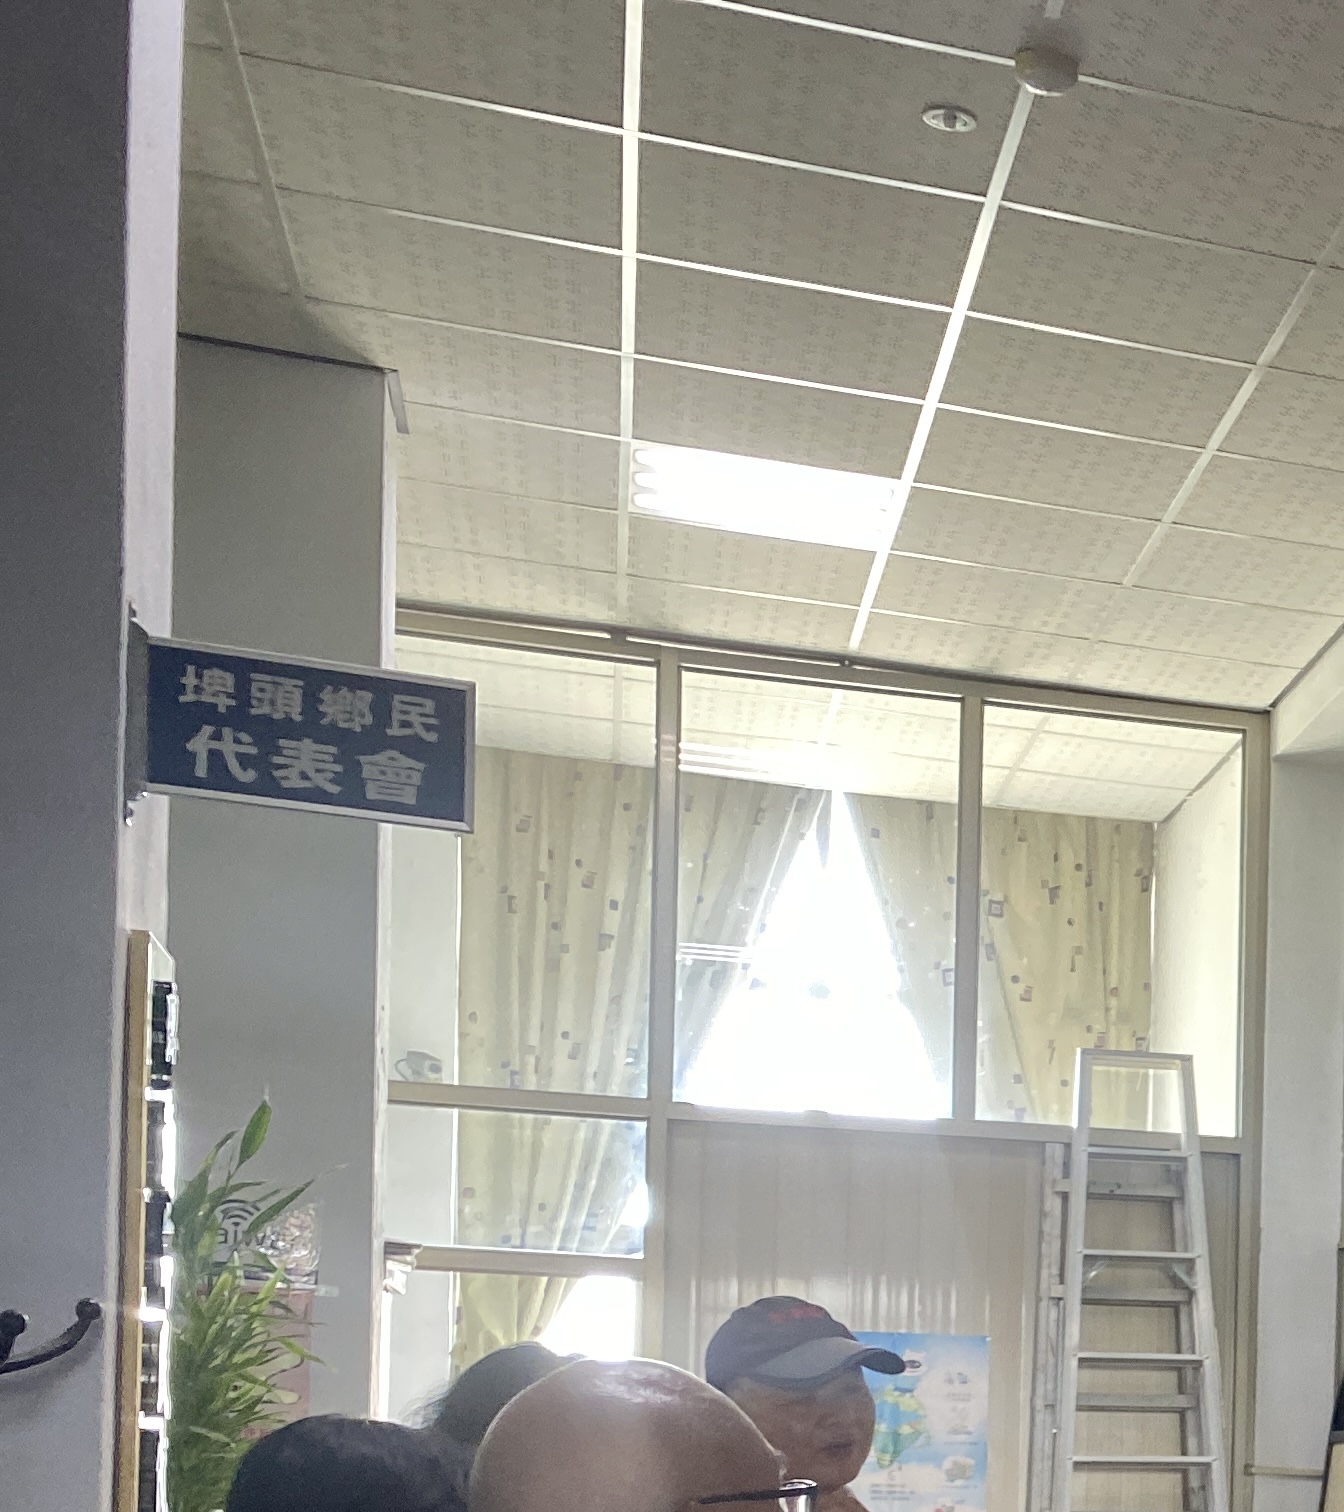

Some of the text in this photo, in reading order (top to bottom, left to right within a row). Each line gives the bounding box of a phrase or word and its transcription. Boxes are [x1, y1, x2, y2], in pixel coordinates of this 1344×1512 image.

[178, 664, 440, 743] 埤頭鄉民
[185, 725, 426, 805] 代表會
